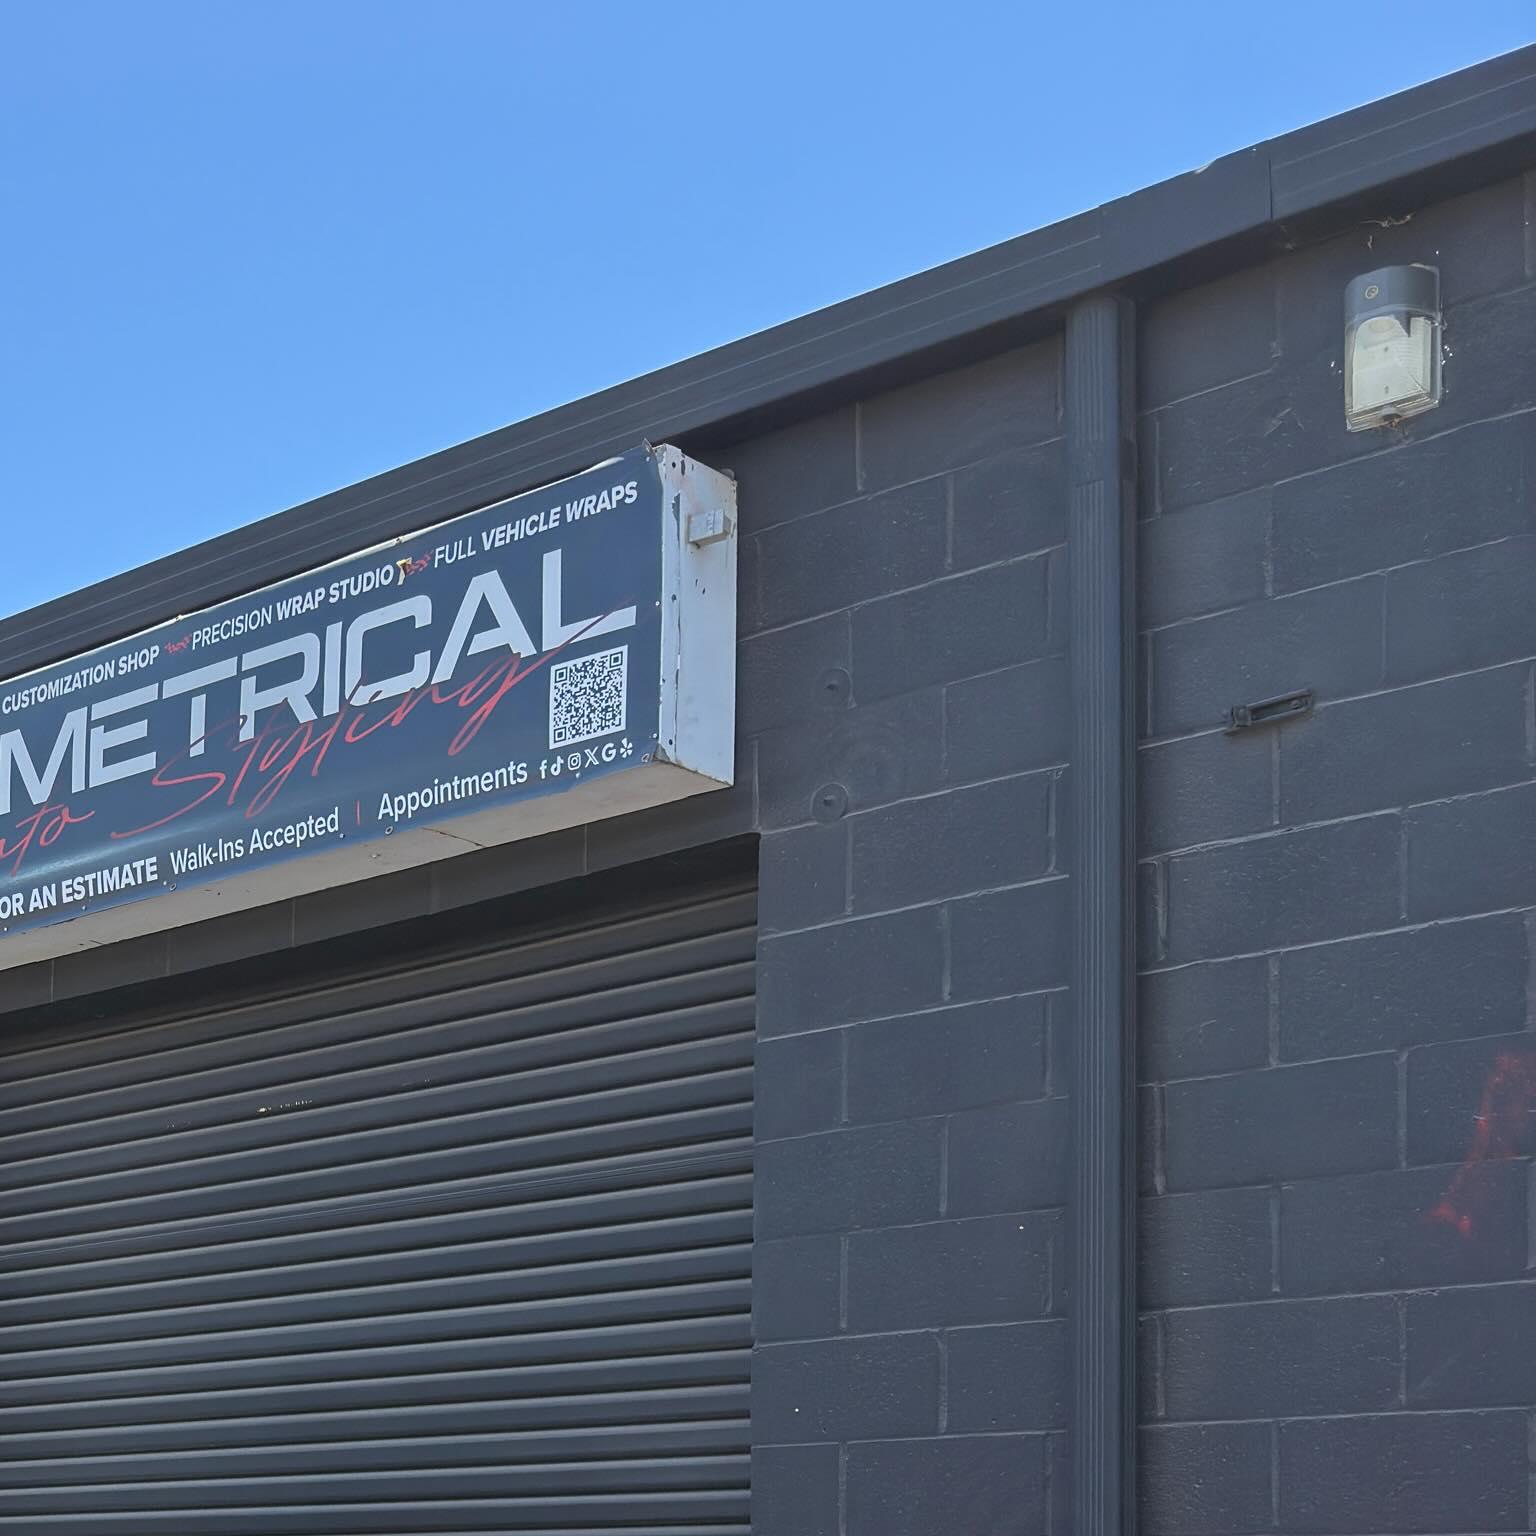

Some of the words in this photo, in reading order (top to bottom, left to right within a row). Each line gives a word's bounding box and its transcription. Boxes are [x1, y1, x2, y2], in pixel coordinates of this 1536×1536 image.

[434, 536, 476, 568] FULL
[481, 507, 561, 550] VEHICLE
[565, 481, 638, 523] WRAPS
[192, 605, 273, 650] PRECISION
[276, 588, 326, 621] WRAP
[329, 564, 394, 603] STUDIO
[2, 660, 115, 714] CUSTOMIZATION
[118, 645, 160, 675] SHOP
[111, 595, 632, 839] Styling
[29, 884, 57, 913] AN
[62, 856, 158, 903] ESTIMATE
[170, 834, 244, 875] Walk-Ins
[249, 806, 340, 857] Accepted
[378, 760, 528, 821] Appointments
